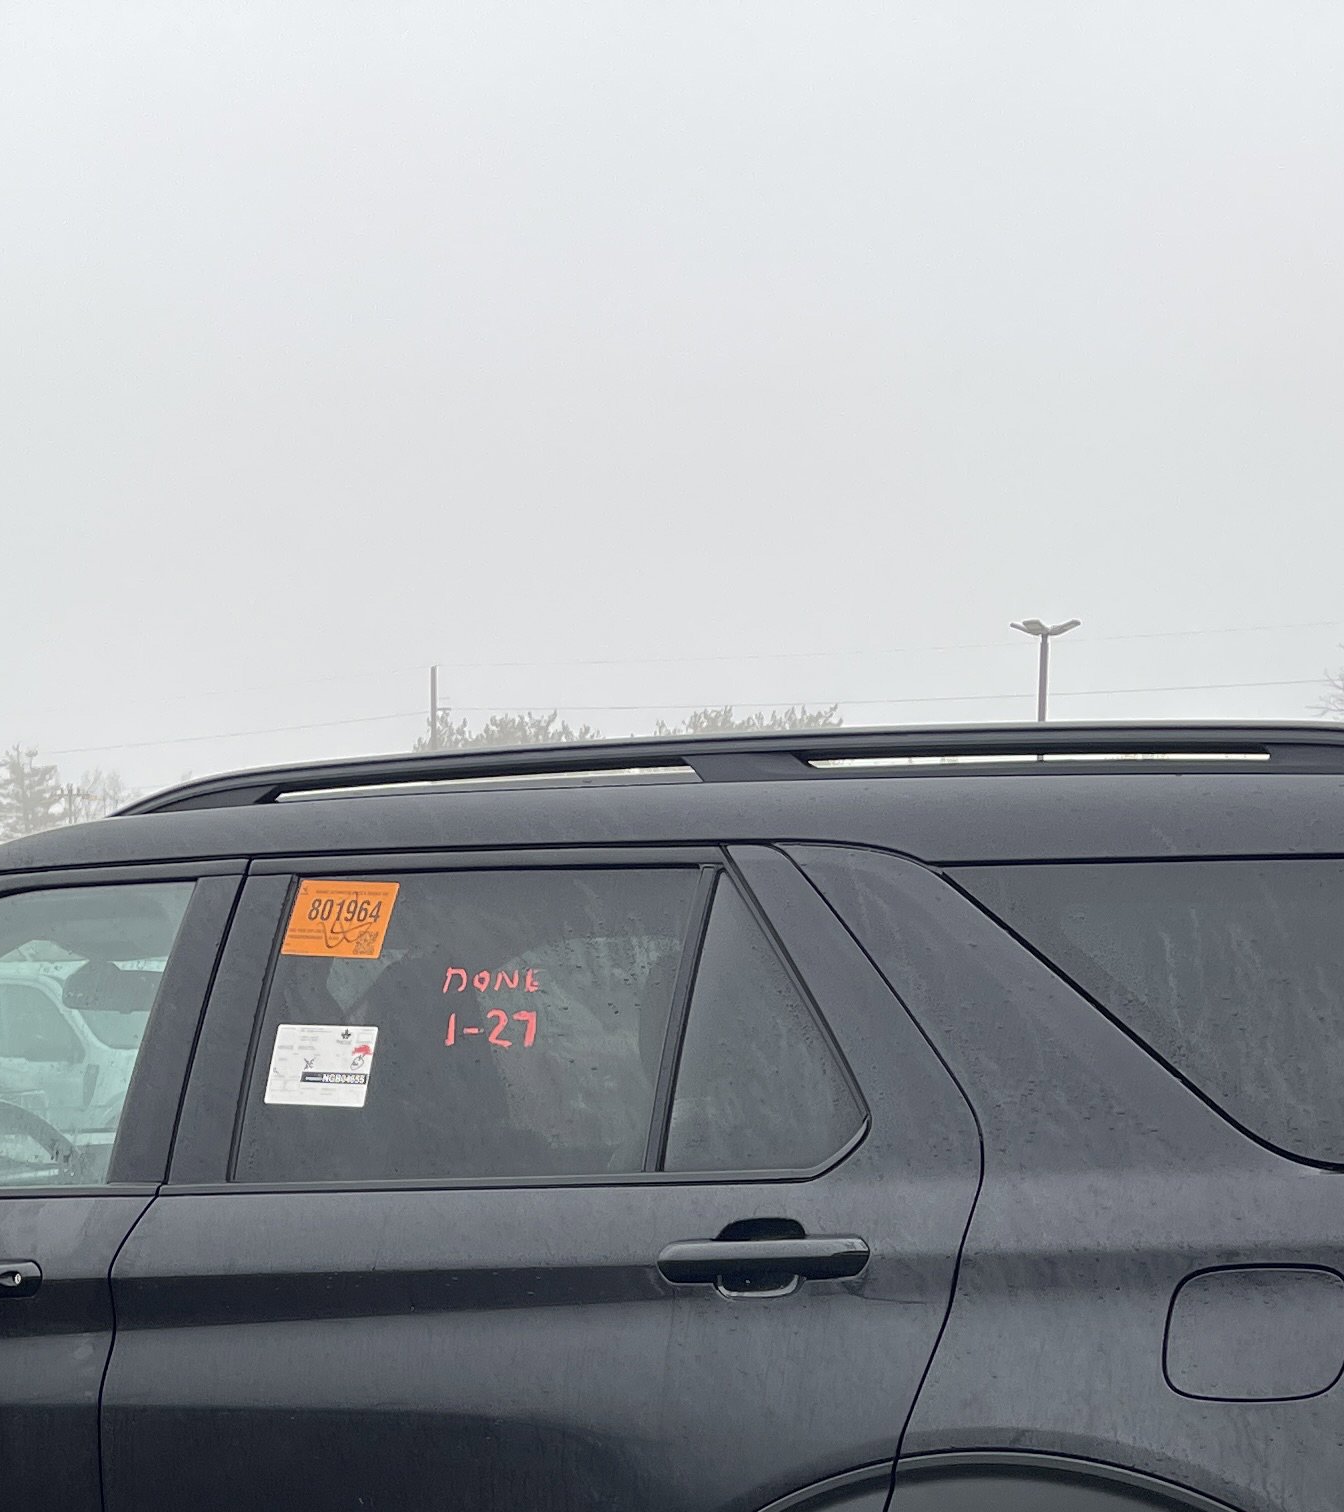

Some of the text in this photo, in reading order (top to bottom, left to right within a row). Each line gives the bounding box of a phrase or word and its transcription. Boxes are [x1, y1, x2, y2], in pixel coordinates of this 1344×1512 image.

[308, 899, 382, 922] 801964
[442, 967, 542, 993] DONE
[444, 1008, 537, 1048] 1-27
